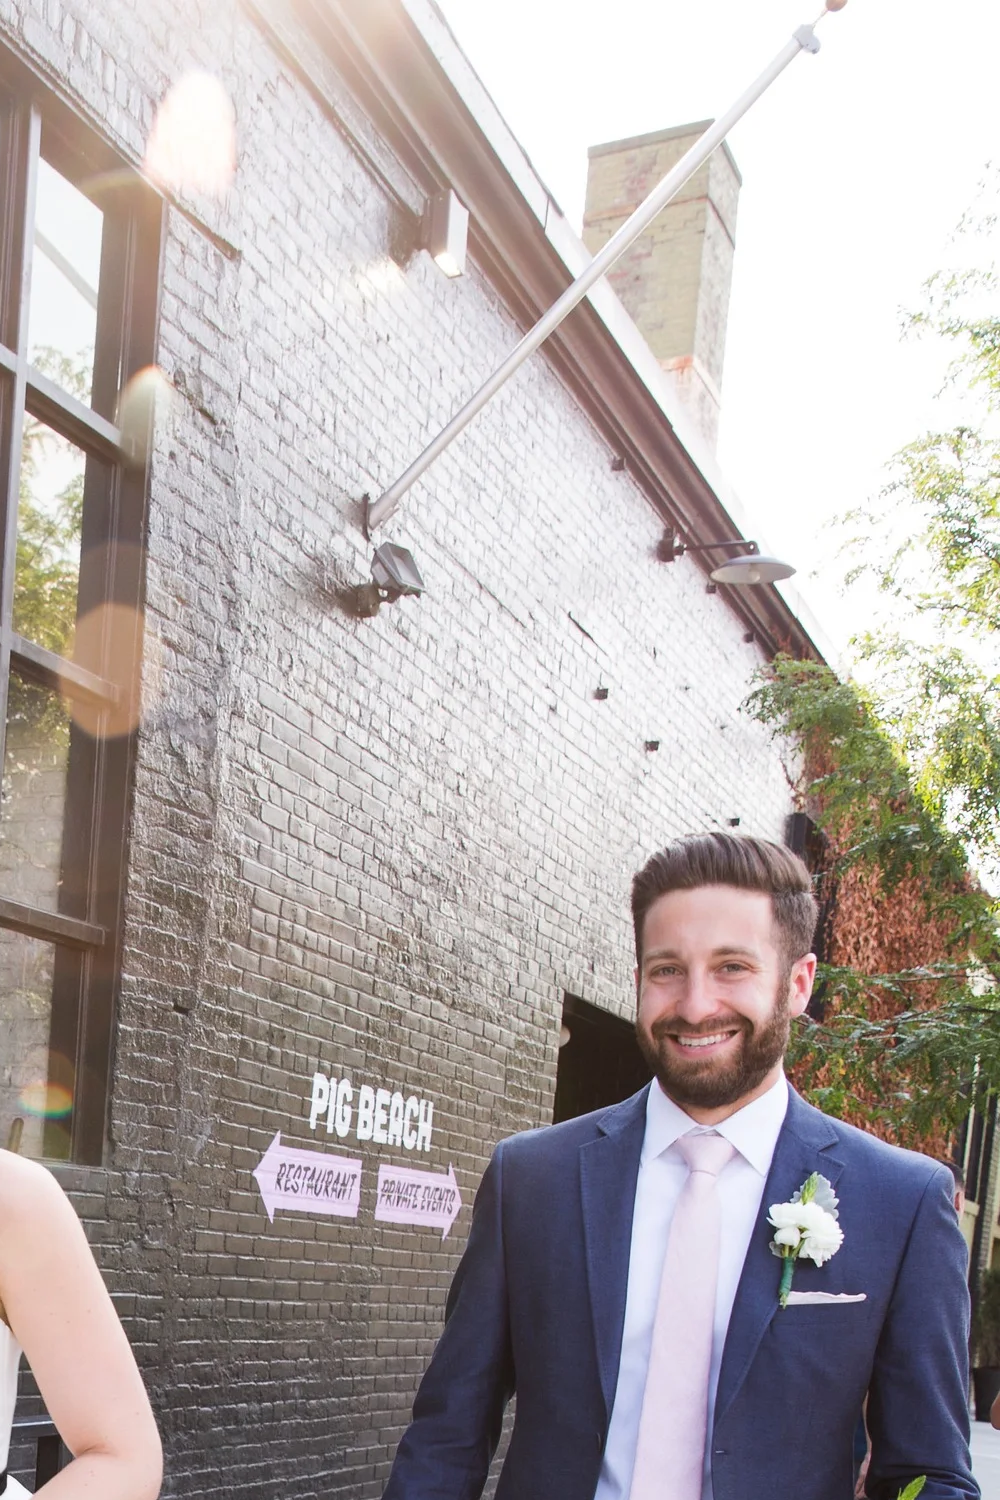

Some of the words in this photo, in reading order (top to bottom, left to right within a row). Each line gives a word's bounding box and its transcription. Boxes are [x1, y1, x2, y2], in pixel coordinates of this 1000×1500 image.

[310, 1072, 353, 1137] PIG
[357, 1084, 434, 1152] BEACH
[274, 1162, 358, 1200] RESTAURANT
[379, 1179, 421, 1209] PRIVATE
[420, 1185, 456, 1215] EVENTS
